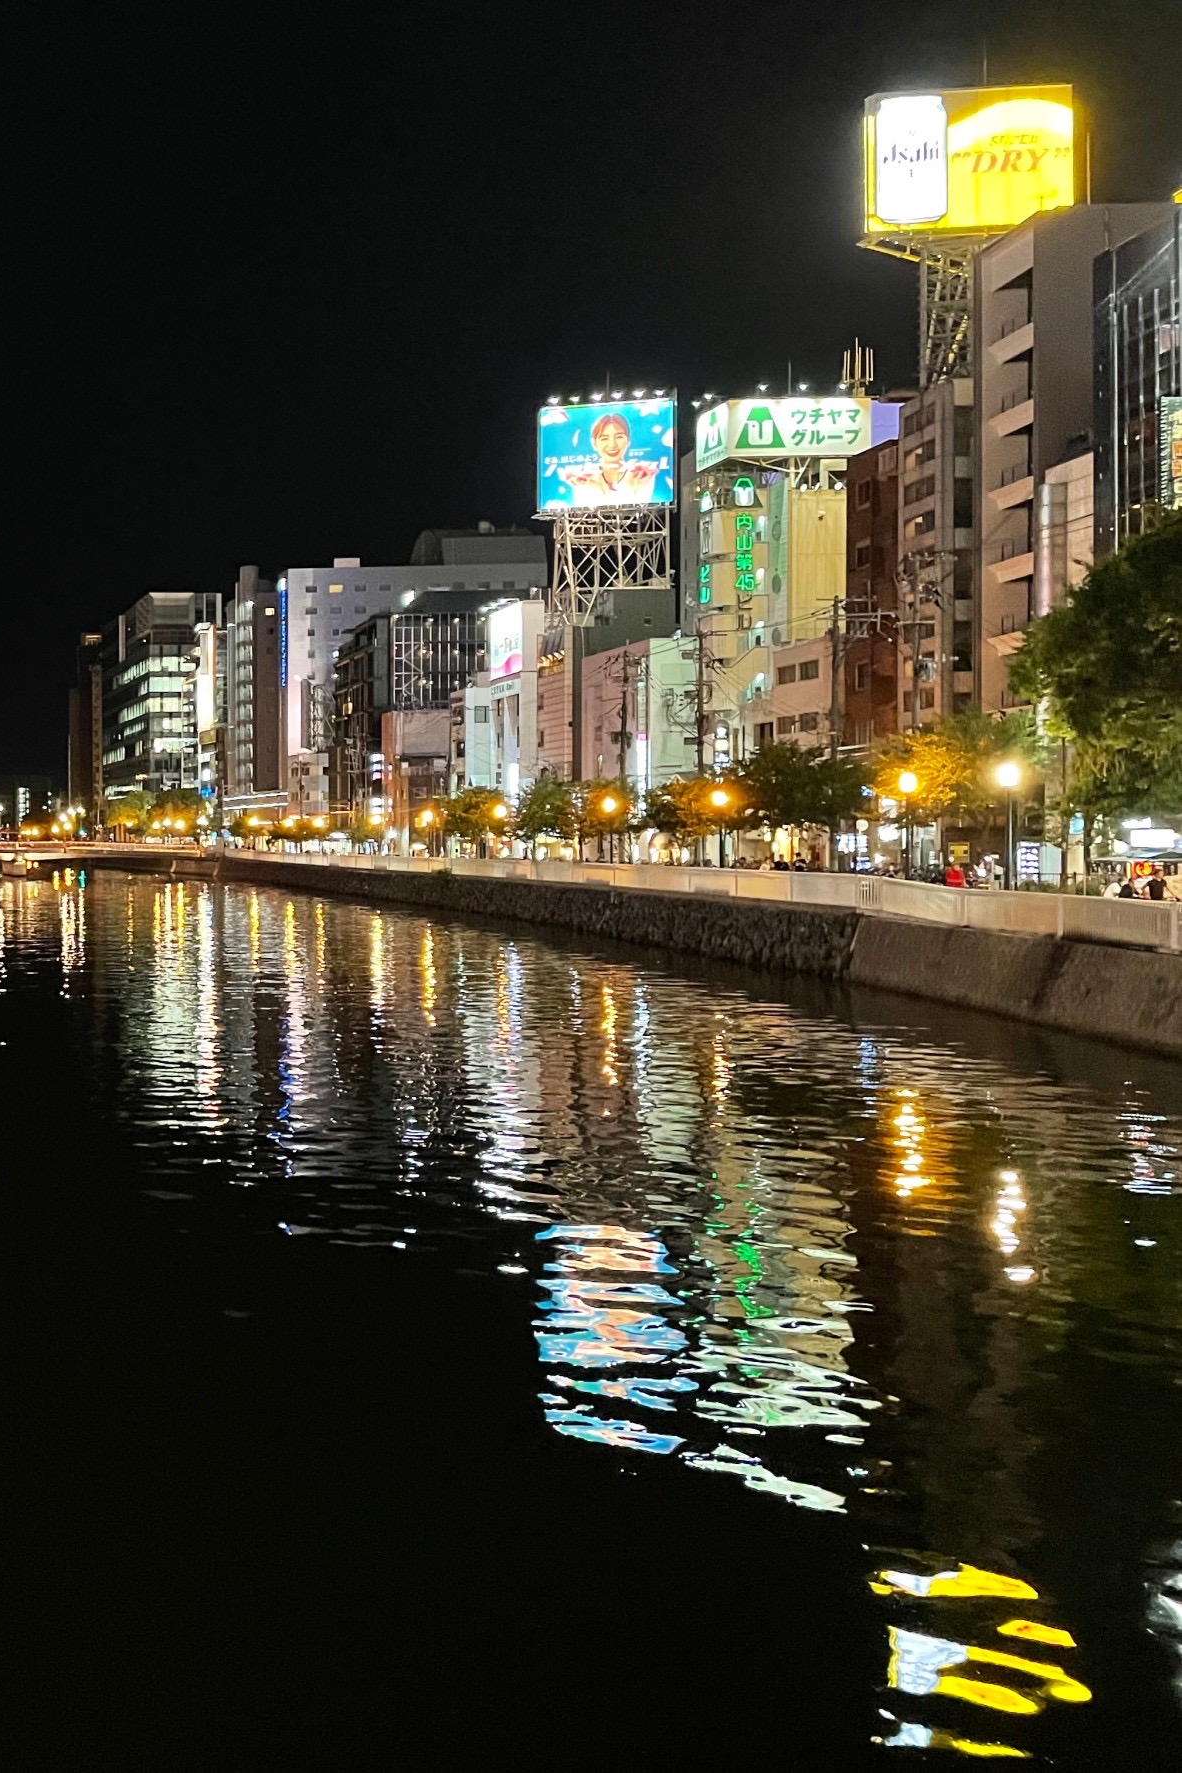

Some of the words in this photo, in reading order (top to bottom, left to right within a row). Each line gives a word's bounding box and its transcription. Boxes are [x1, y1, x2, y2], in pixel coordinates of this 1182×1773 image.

[883, 140, 939, 164] Asahi
[790, 407, 861, 425] ウチヤマ
[790, 428, 863, 447] グループ
